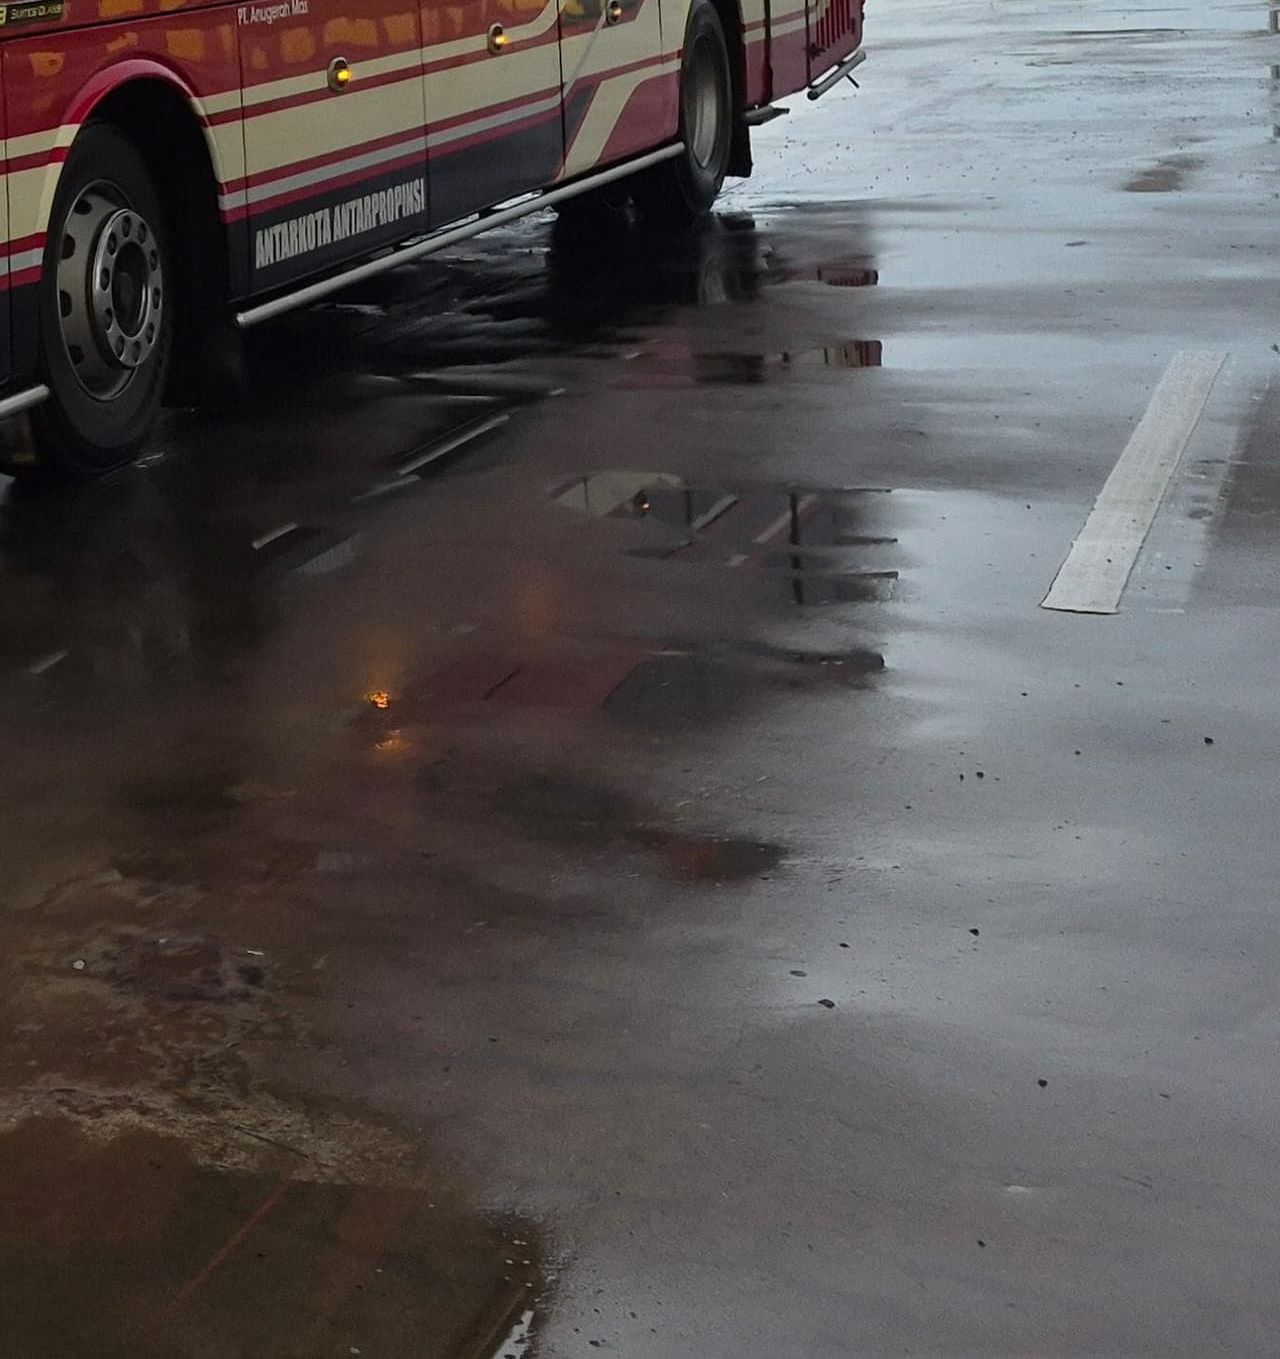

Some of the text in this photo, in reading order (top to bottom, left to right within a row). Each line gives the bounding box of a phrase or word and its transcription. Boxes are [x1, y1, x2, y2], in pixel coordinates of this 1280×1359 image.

[250, 1, 291, 25] Anugerah
[255, 176, 426, 270] ANTARKOTA ANTARPROPINSI
